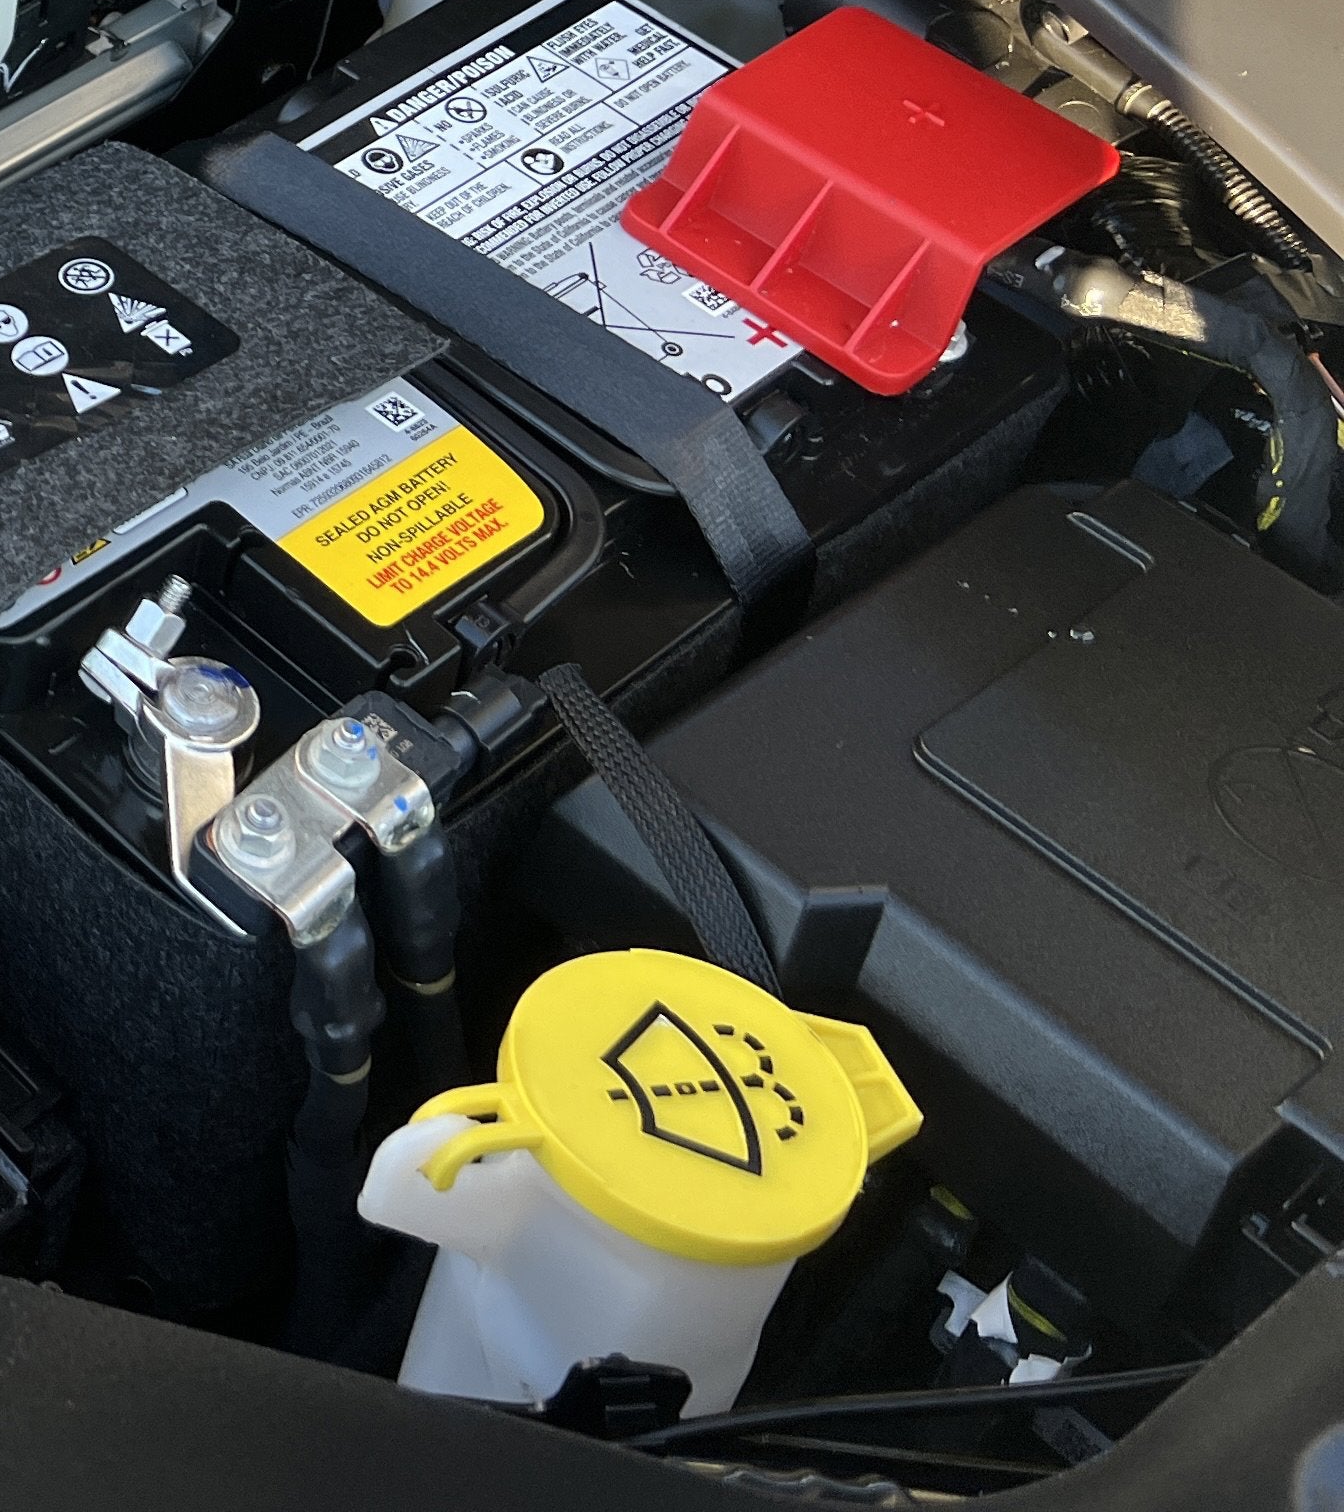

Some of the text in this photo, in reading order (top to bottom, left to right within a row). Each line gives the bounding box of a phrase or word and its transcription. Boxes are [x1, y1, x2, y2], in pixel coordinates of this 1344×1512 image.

[546, 17, 598, 50] FLUSH EYES
[558, 22, 614, 57] IMMEDIATELY
[627, 31, 667, 55] MEDICAL
[634, 22, 654, 36] GET
[570, 32, 627, 65] WITH WATER.
[631, 38, 680, 68] HELP FAST.
[386, 45, 514, 121] DANGER/POISON
[484, 69, 530, 96] SULFURIC
[498, 89, 523, 106] ACID
[613, 98, 629, 108] DO
[623, 89, 642, 101] NOT
[638, 78, 661, 92] OPEN
[510, 87, 554, 113] CAN CAUSE
[522, 88, 576, 121] BLINDNESS OR
[433, 119, 452, 132] NO
[460, 122, 493, 143] SPARKS
[534, 110, 565, 129] SEVERE
[471, 129, 505, 150] FLAMES
[483, 135, 520, 158] SMOKING
[548, 130, 571, 146] READ
[400, 159, 435, 181] GASES
[405, 166, 451, 194] BLINDNESS
[471, 224, 496, 240] RISK
[490, 216, 505, 228] OF
[520, 180, 566, 210] EXPLOSION
[560, 173, 578, 184] OR
[598, 149, 616, 161] DO
[610, 139, 631, 154] NOT
[626, 110, 680, 144] DISASSEMBLE
[674, 103, 691, 114] OR
[425, 205, 446, 221] KEEP
[443, 196, 462, 209] OUT
[458, 189, 472, 200] OF
[467, 181, 488, 193] THE
[474, 219, 528, 254] COMMENDED
[523, 209, 545, 224] FOR
[539, 187, 579, 214] INVERTED
[591, 158, 626, 181] FOLLOW
[620, 141, 654, 163] PROPER
[527, 222, 558, 240] Battery
[601, 183, 618, 195] and
[436, 210, 465, 229] REACH
[460, 203, 473, 214] OF
[519, 251, 536, 261] the
[530, 240, 553, 254] State
[549, 233, 561, 243] of
[555, 217, 591, 238] California
[532, 259, 549, 270] the
[542, 248, 565, 263] State
[562, 241, 573, 252] of
[568, 225, 603, 246] California
[315, 509, 370, 546] SEALED
[368, 489, 401, 514] AGM
[397, 452, 457, 494] BATTERY
[355, 480, 450, 543] DO NOT OPEN!
[366, 492, 472, 563] NON-SPILLABLE
[366, 498, 502, 588] LIMIT CHARGE VOLTAGE
[389, 517, 507, 593] TO 14.4 VOLTS MAX.
